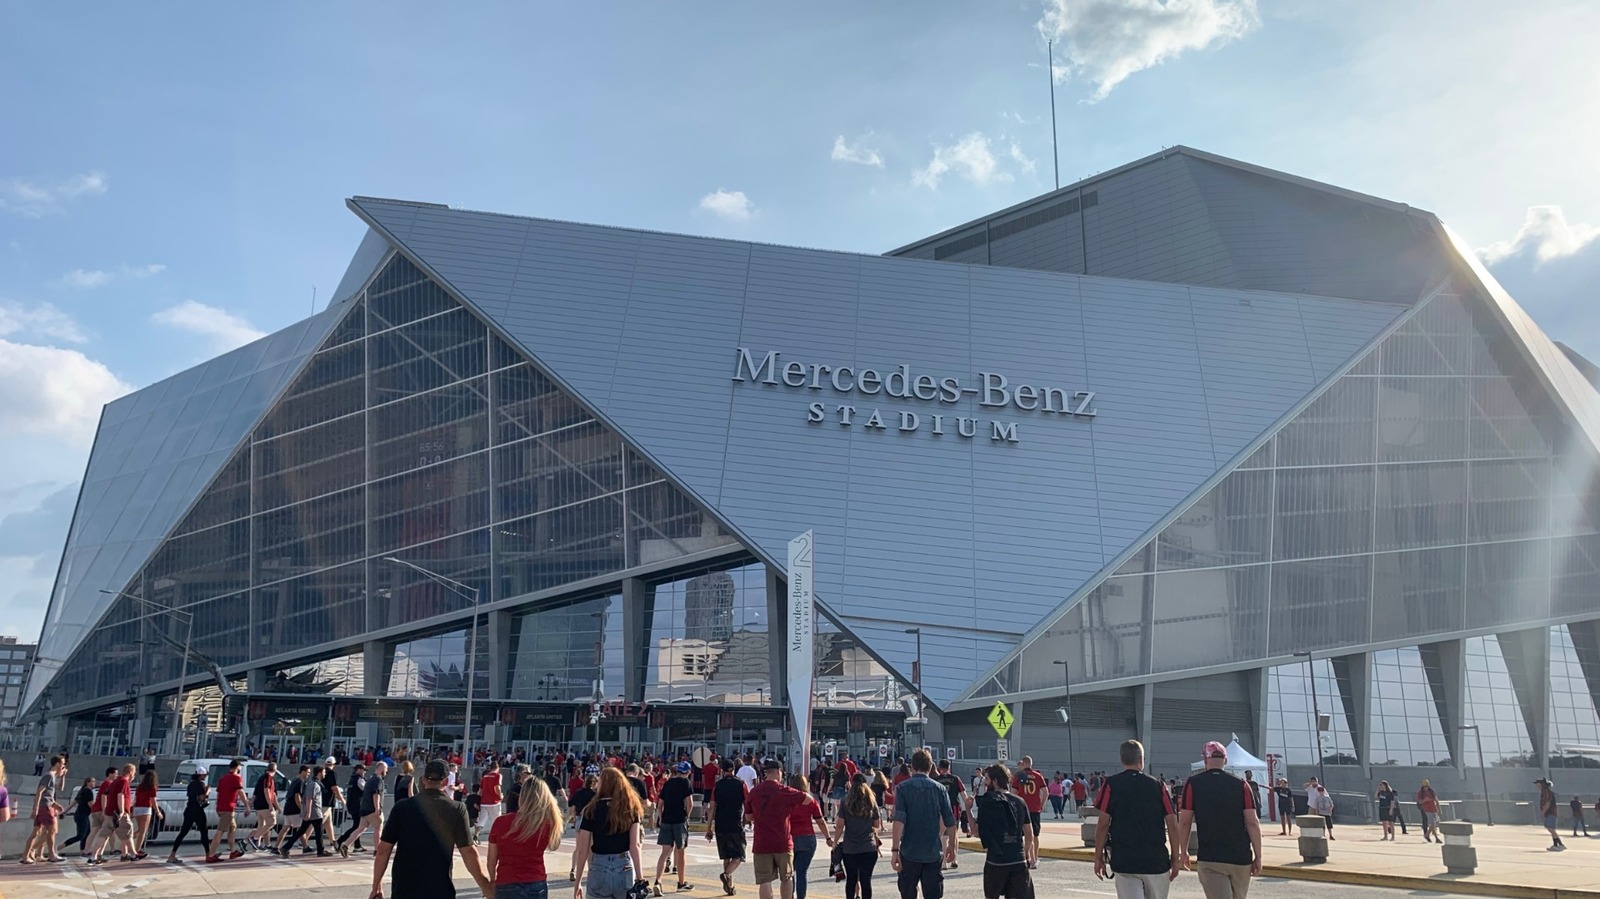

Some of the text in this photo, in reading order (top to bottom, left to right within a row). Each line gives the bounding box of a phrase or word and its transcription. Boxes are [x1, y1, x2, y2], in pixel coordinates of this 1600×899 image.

[732, 347, 1097, 417] Mercedes-Benz
[808, 402, 1020, 443] STADIUM
[793, 533, 811, 568] 2
[792, 573, 802, 652] Mercedes-Benz
[637, 700, 648, 717] 2
[999, 750, 1007, 759] 15
[1024, 780, 1036, 795] 10
